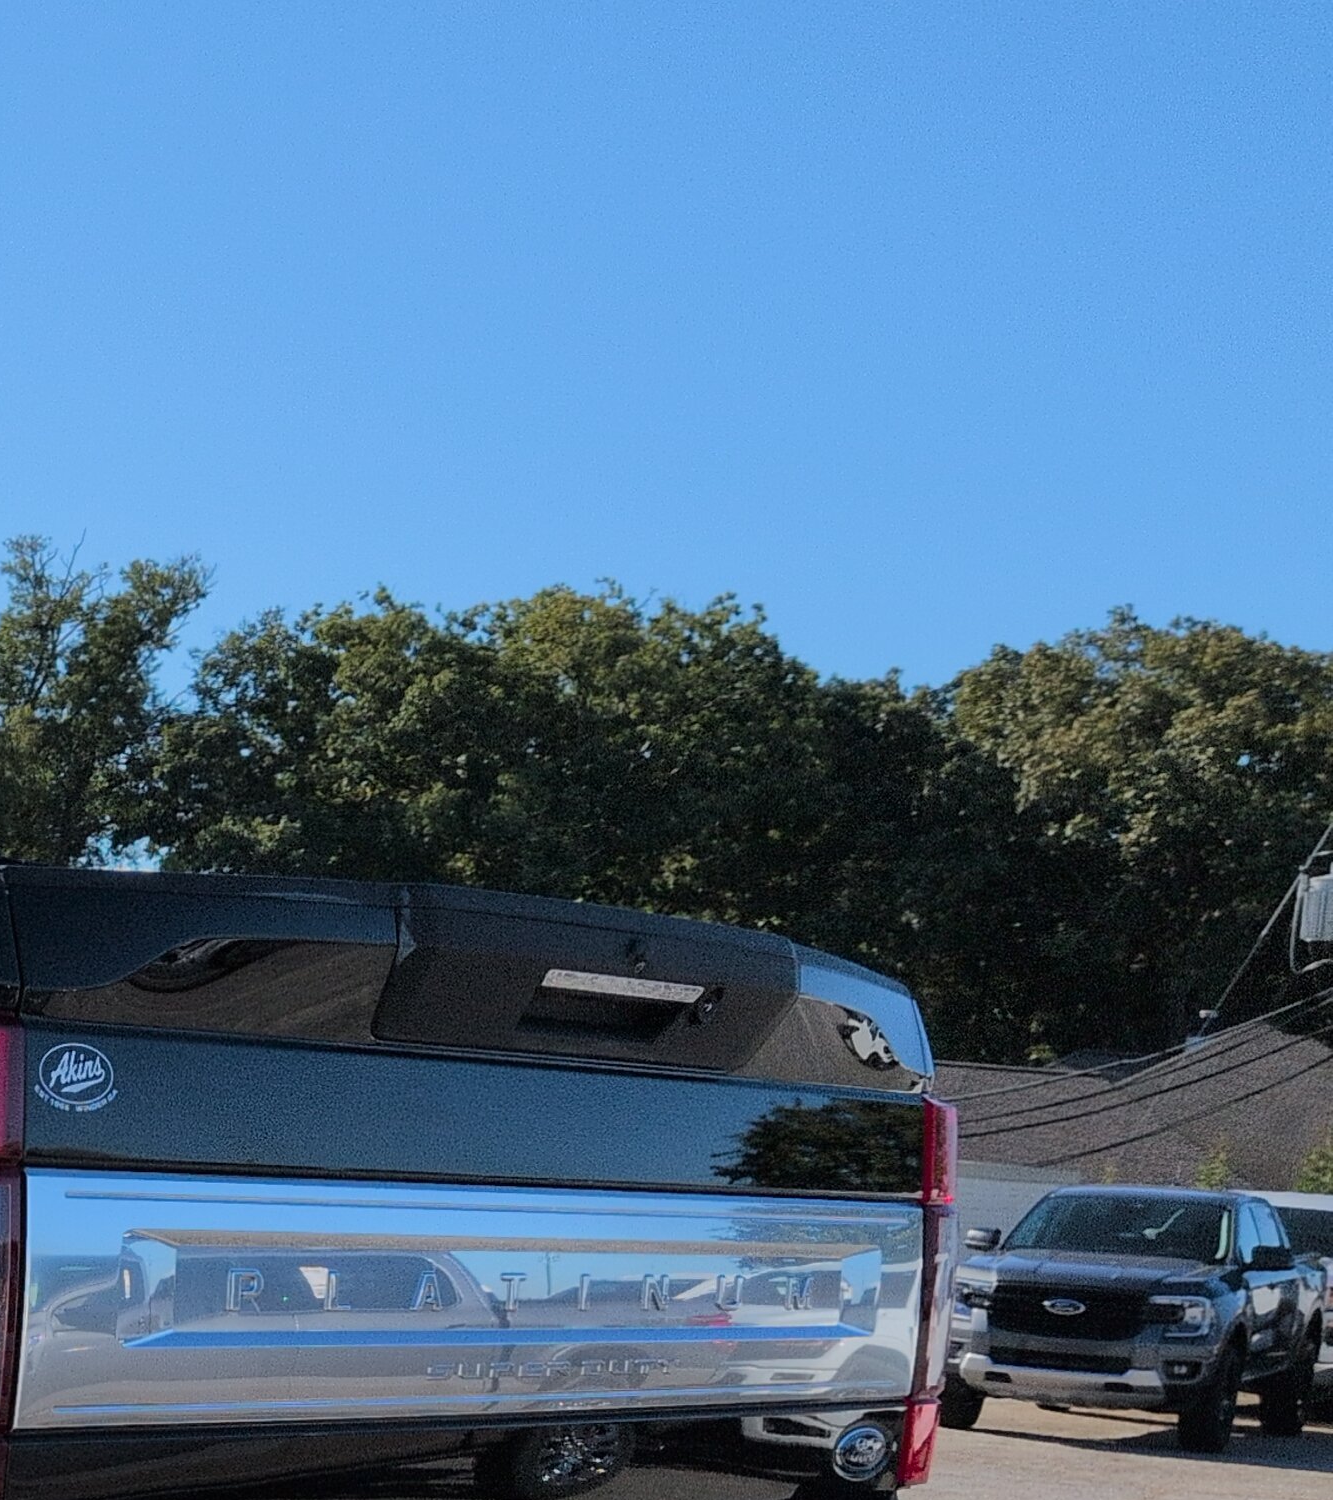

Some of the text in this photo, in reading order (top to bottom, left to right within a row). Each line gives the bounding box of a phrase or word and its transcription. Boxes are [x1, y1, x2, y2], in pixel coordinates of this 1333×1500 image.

[49, 1050, 105, 1092] Akins
[226, 1267, 816, 1312] PLATINUM
[426, 1357, 679, 1382] SUPER DUTY
